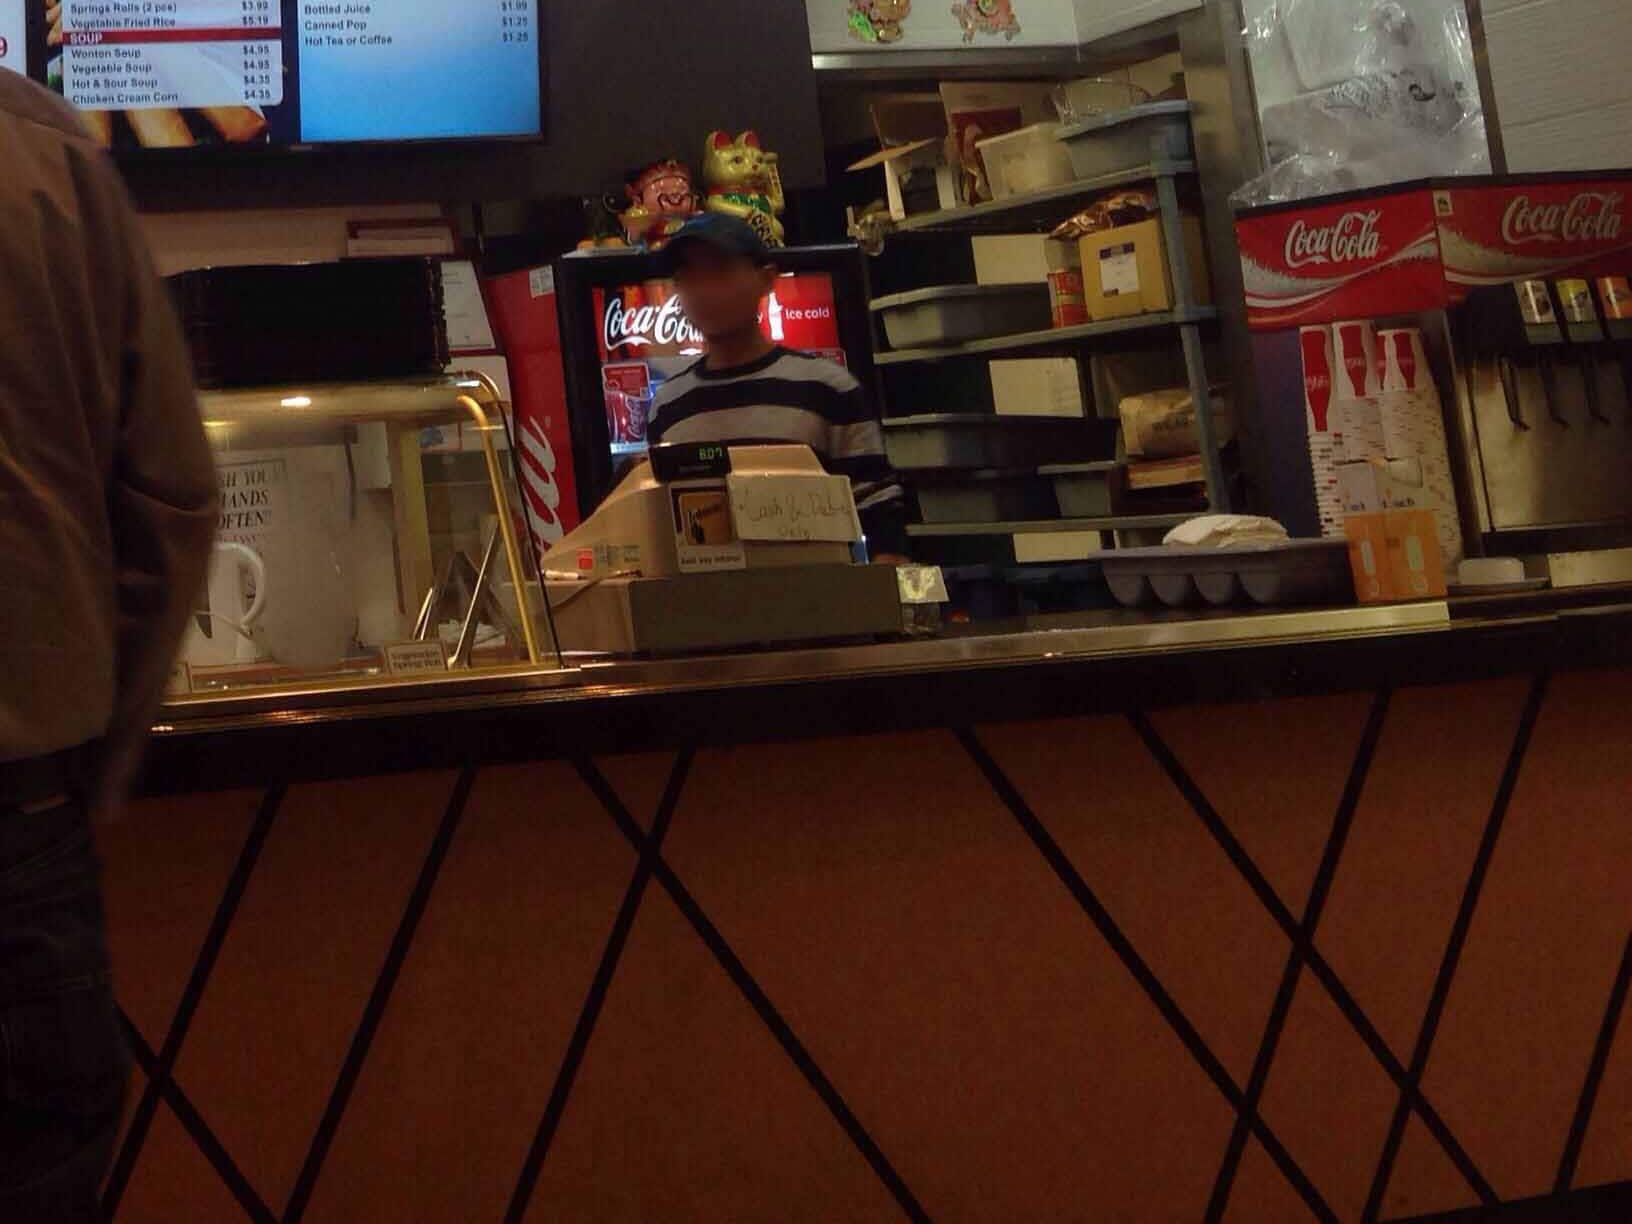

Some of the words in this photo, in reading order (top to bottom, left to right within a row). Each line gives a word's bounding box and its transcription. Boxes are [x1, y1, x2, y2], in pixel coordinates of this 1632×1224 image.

[304, 4, 341, 15] Bottled
[343, 4, 372, 15] Juice
[123, 18, 151, 28] Fried
[153, 17, 177, 27] Rice
[304, 20, 344, 31] Canned
[346, 19, 367, 32] Pop
[70, 32, 104, 45] SOUP
[304, 36, 323, 46] Hot
[325, 35, 344, 46] Tea
[345, 37, 358, 45] or
[359, 34, 393, 45] Coffee
[71, 48, 112, 59] Wonton
[114, 47, 142, 60] Soup
[71, 63, 123, 76] Vegetable
[125, 61, 153, 75] Soup
[72, 78, 91, 90] Hot
[130, 77, 159, 89] Soup
[72, 93, 116, 105] Chicken
[117, 93, 152, 104] Cream
[153, 91, 179, 102] Corn
[1501, 192, 1624, 246] Coca-Cola
[1284, 208, 1382, 269] Coca-Cola
[804, 306, 831, 319] cold
